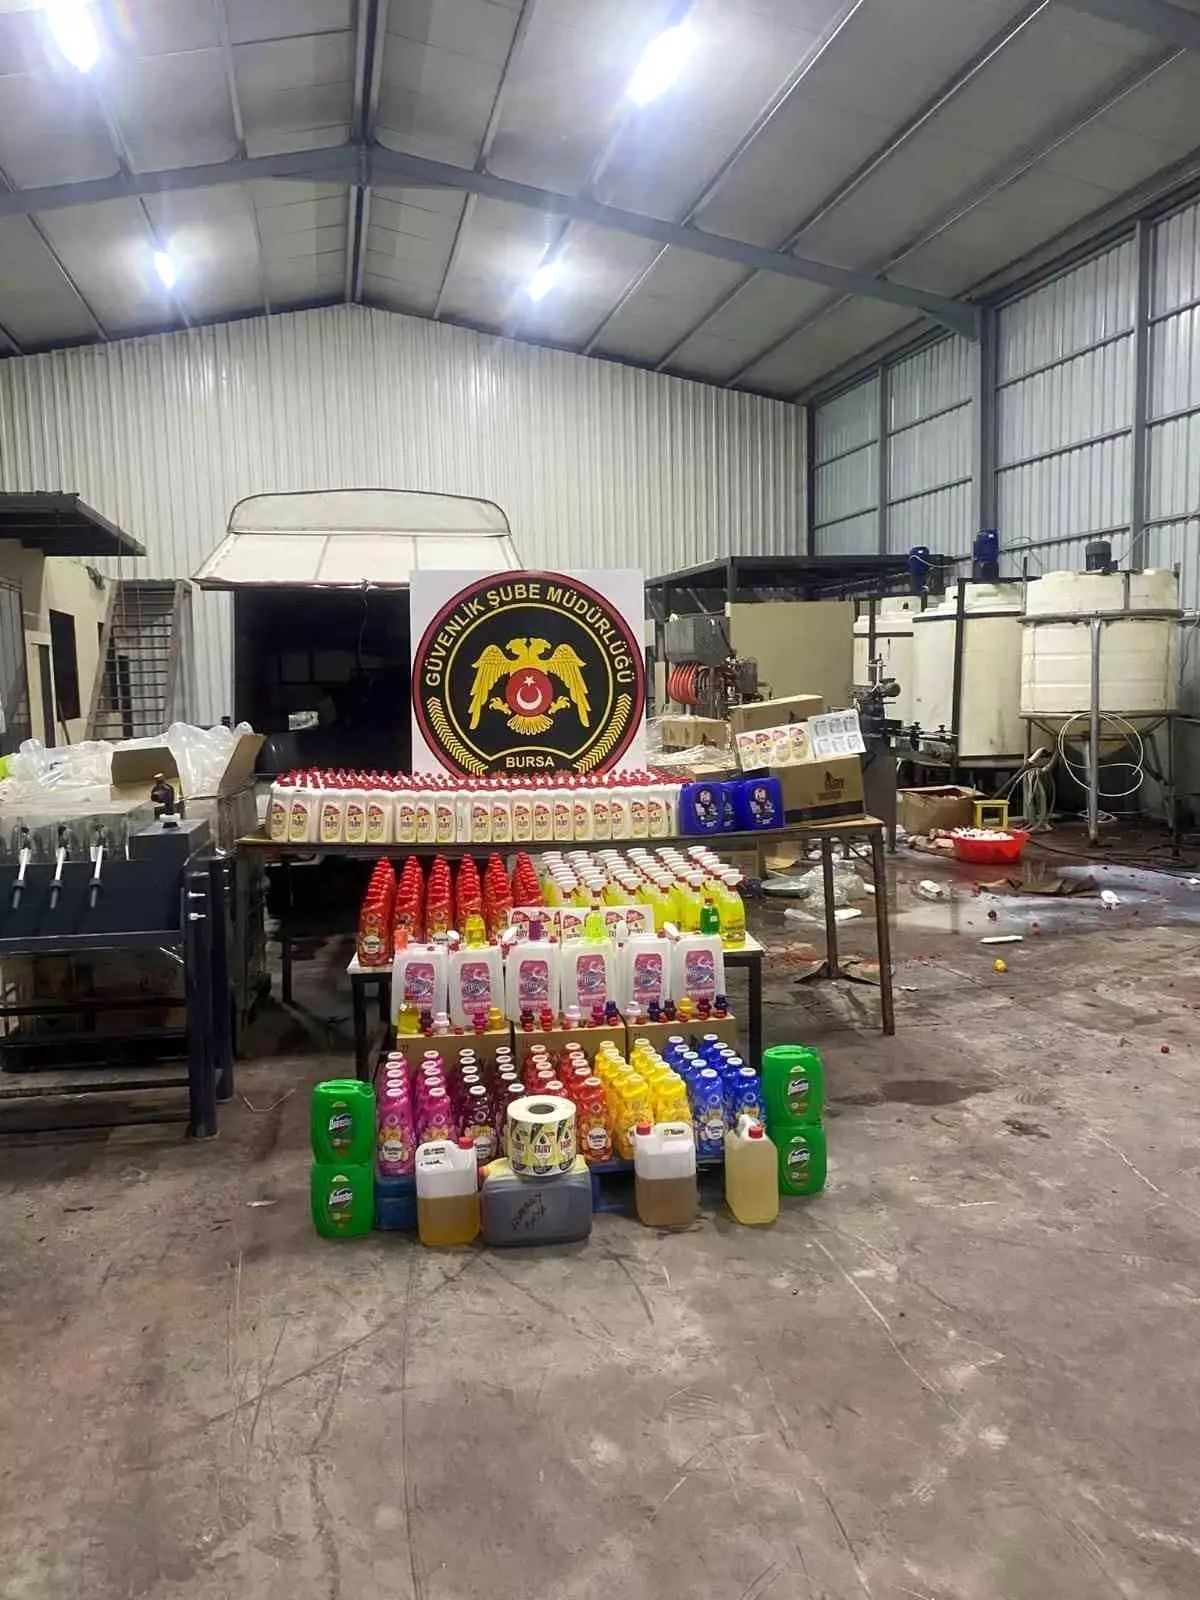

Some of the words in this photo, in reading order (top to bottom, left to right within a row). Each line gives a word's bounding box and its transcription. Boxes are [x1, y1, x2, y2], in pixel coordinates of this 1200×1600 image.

[425, 598, 486, 686] GÜVENLİK
[486, 583, 541, 609] ŞUBE
[546, 586, 635, 683] MÜDÜRLÜĞÜ
[506, 756, 555, 768] BURSA
